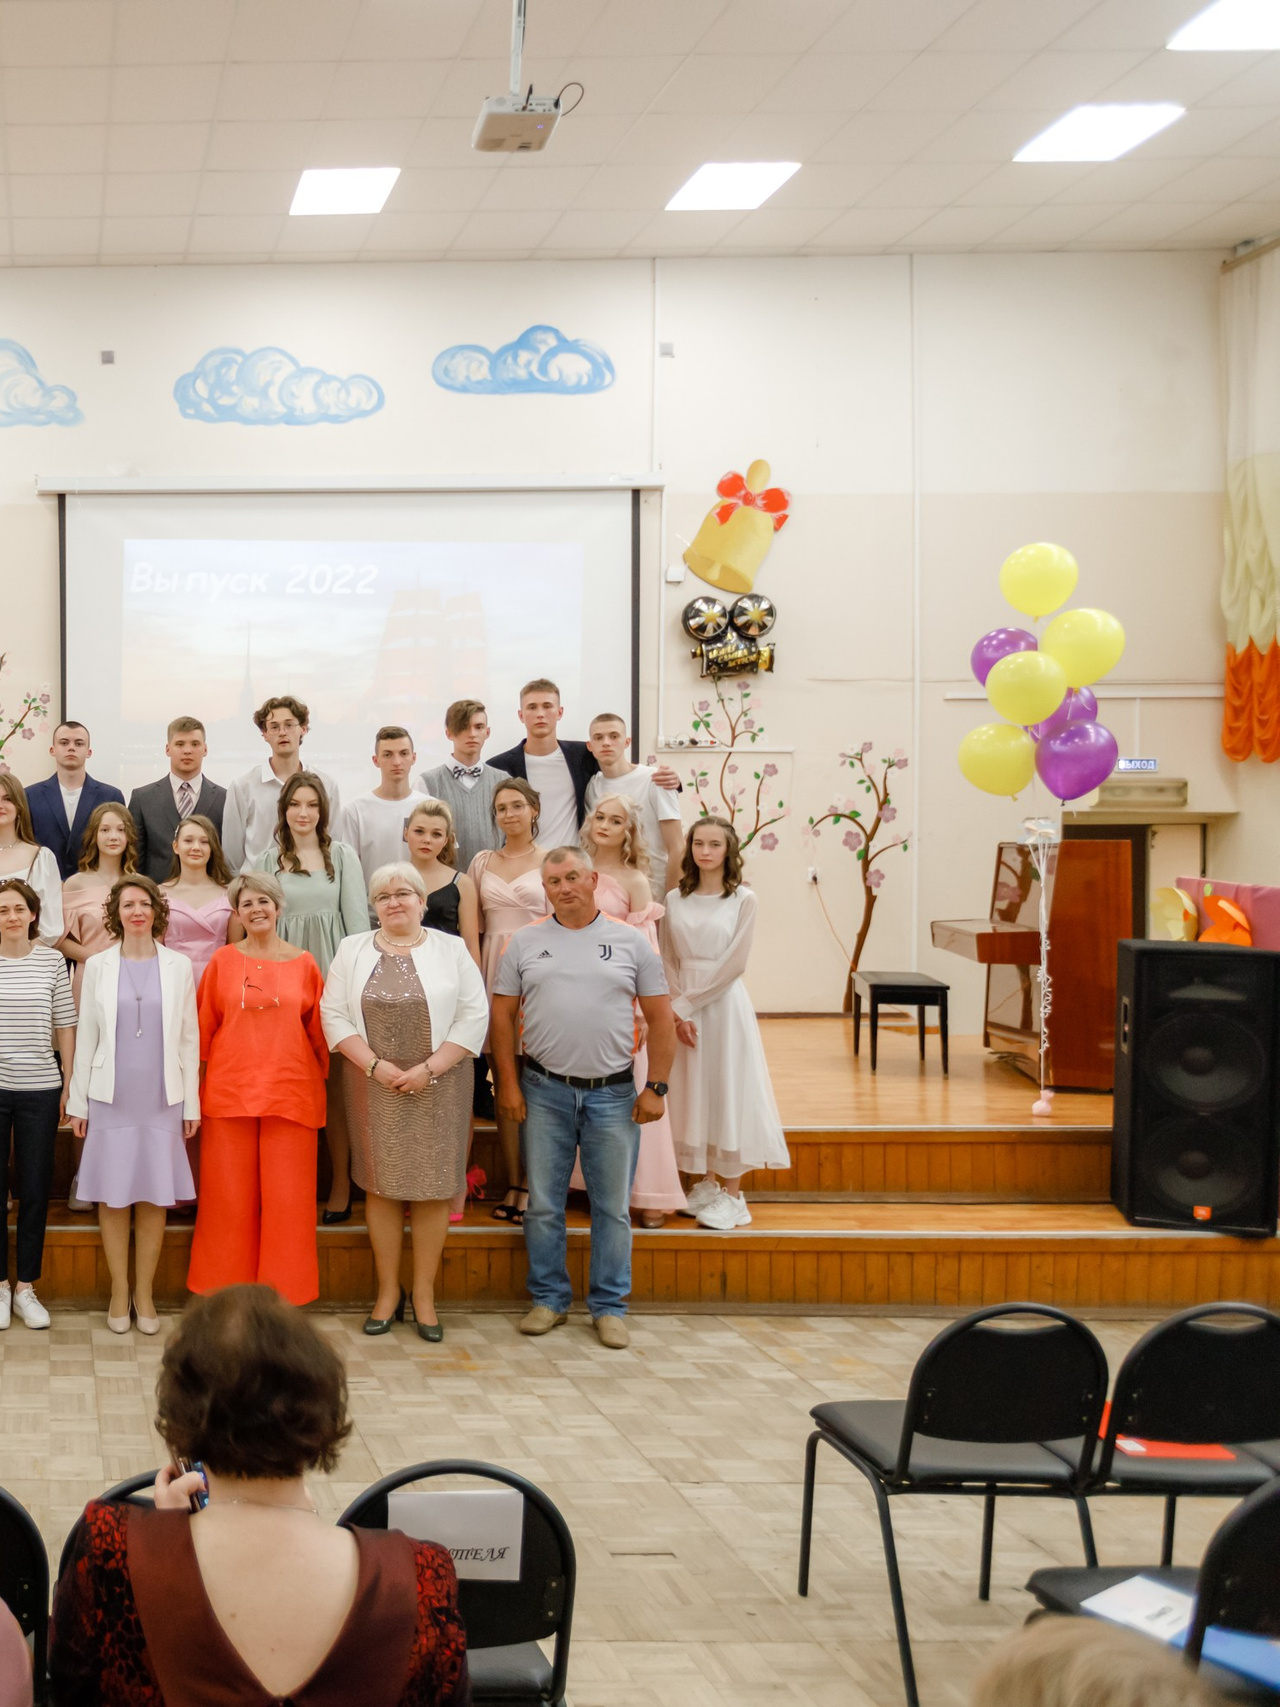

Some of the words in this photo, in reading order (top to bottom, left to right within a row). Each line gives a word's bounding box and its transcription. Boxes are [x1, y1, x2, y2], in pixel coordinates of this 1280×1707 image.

[130, 561, 270, 603] Выпуск
[285, 563, 379, 595] 2022
[1119, 760, 1155, 769] ЫХОД
[449, 1546, 510, 1562] ТЕЛЯ
